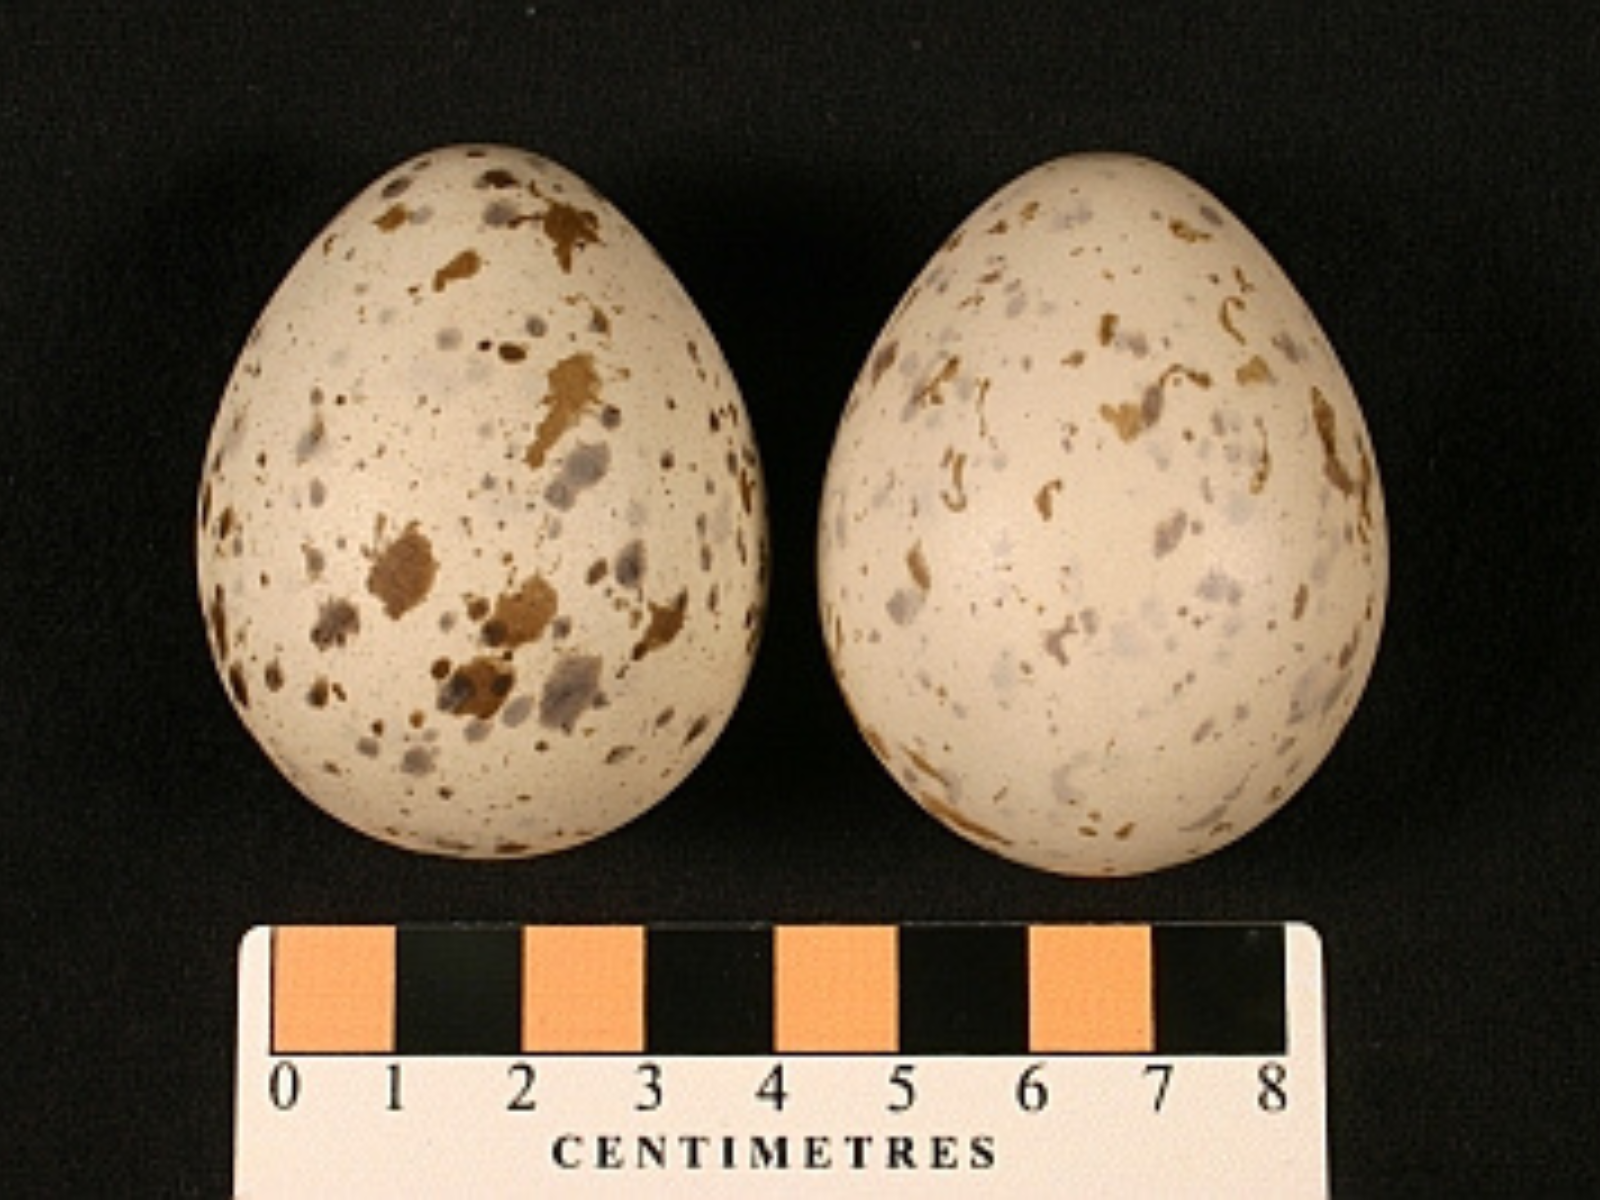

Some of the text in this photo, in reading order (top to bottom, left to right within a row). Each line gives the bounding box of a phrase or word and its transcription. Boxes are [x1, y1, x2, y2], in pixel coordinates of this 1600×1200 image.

[269, 1063, 1287, 1112] 0 1 2 3 4 5 6 7 8
[552, 1135, 996, 1170] CENTIMETRES
